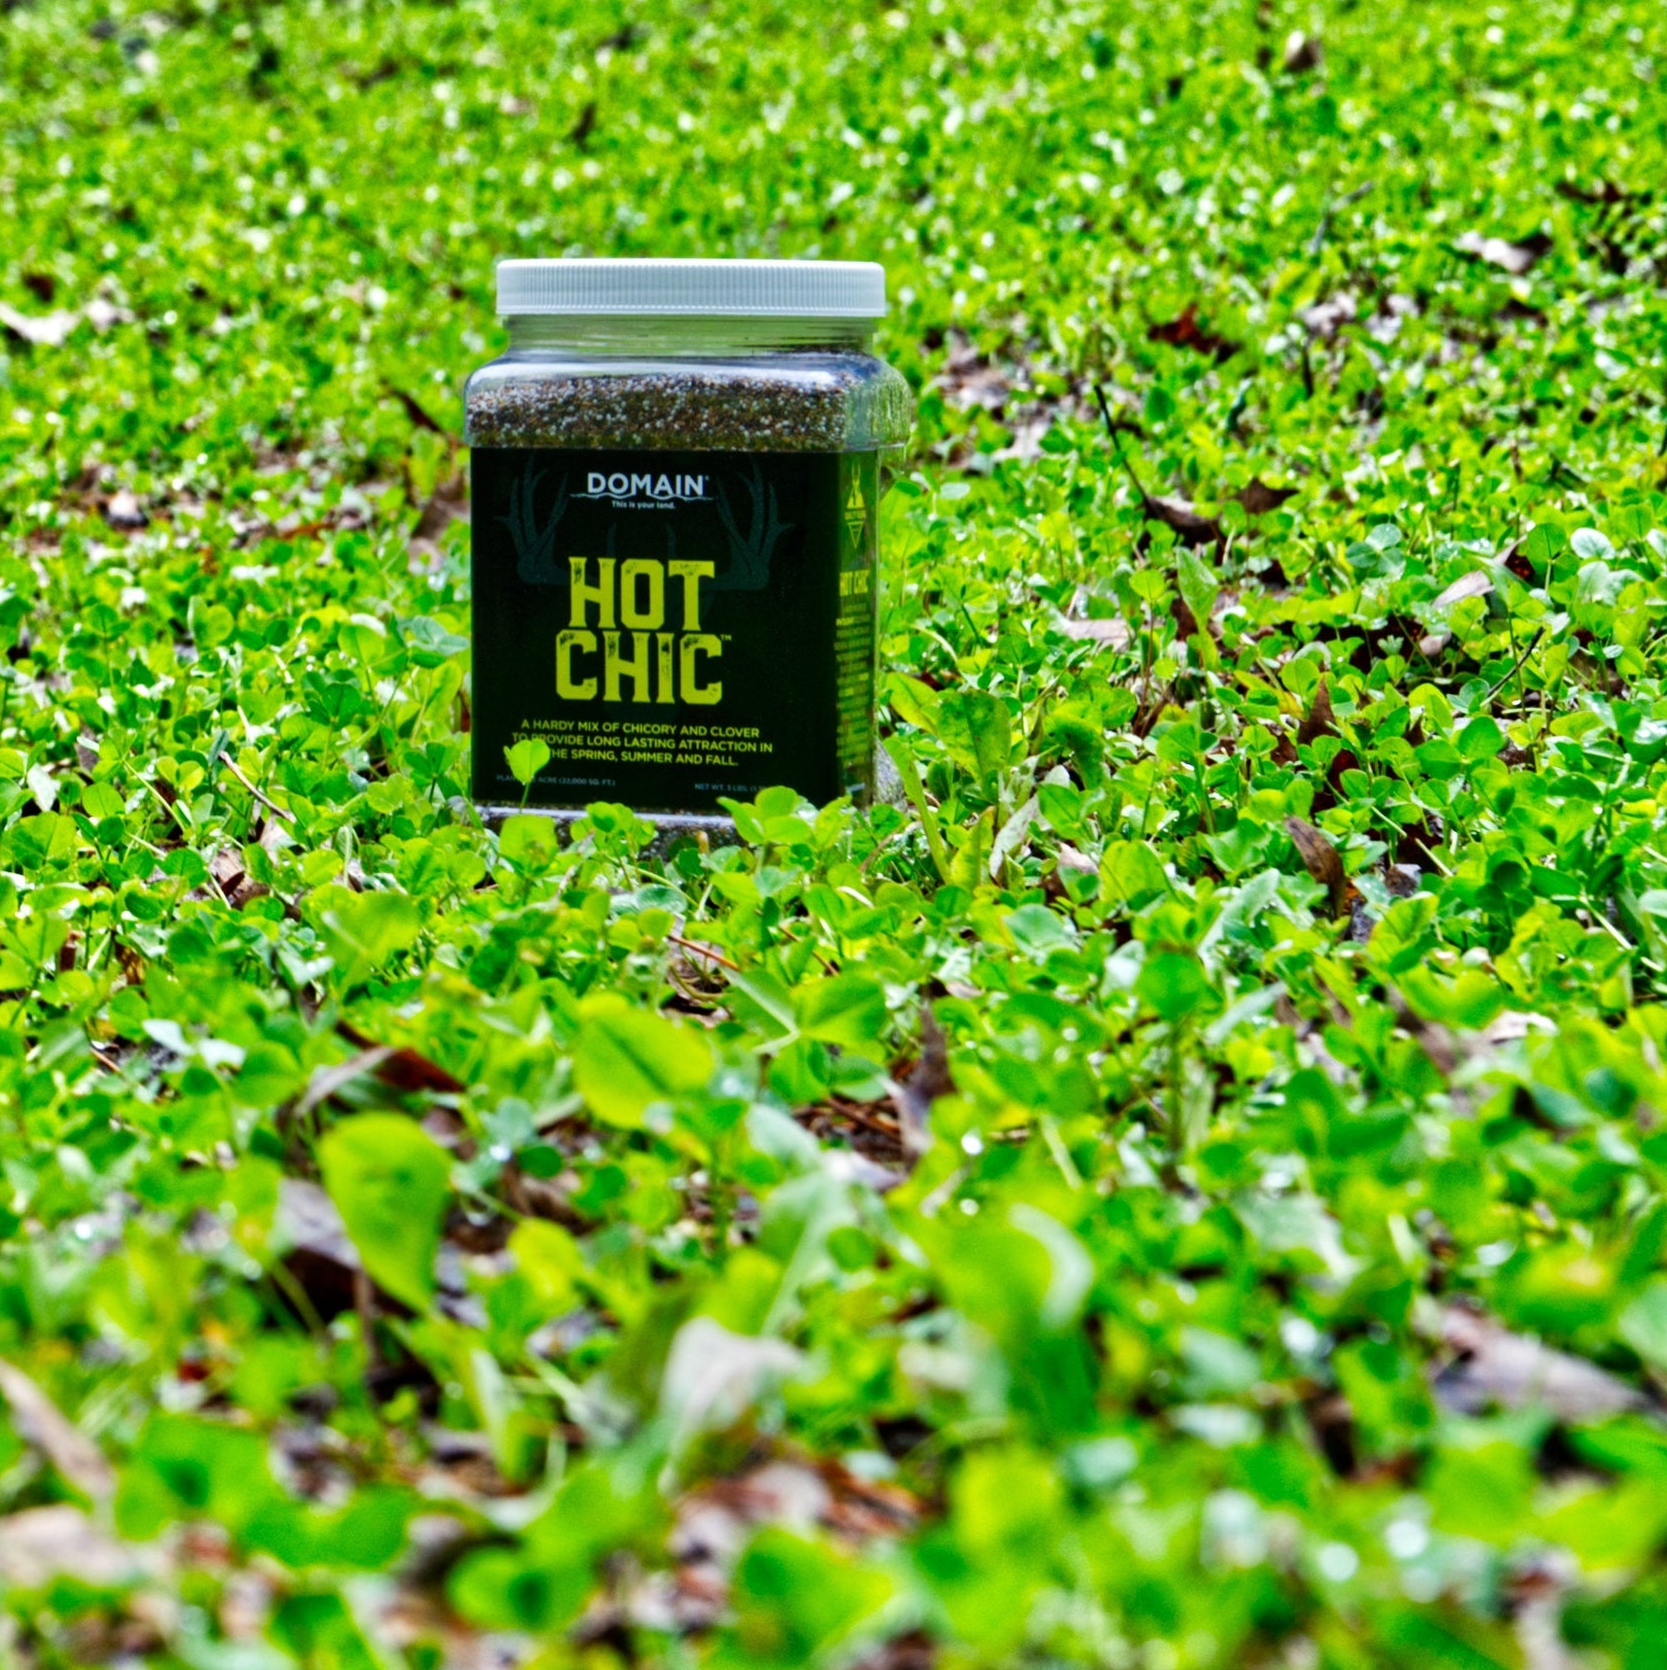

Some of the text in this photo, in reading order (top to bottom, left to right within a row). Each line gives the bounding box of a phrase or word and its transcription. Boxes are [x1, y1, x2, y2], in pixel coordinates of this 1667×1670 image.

[587, 472, 704, 496] DOMAIN
[611, 500, 627, 508] This
[628, 500, 636, 508] is
[637, 502, 655, 510] your
[568, 556, 715, 631] HOT
[555, 629, 722, 705] CHIC
[521, 719, 760, 738] A HARDY MIX OF CHICORY AND CLOVER
[512, 732, 528, 742] TO
[587, 735, 621, 747] LONG
[624, 737, 676, 749] LASTING
[678, 739, 757, 752] ATTRACTION
[760, 742, 773, 753] IN
[550, 748, 739, 766] HE SPRING, SUMMER AND FALL.
